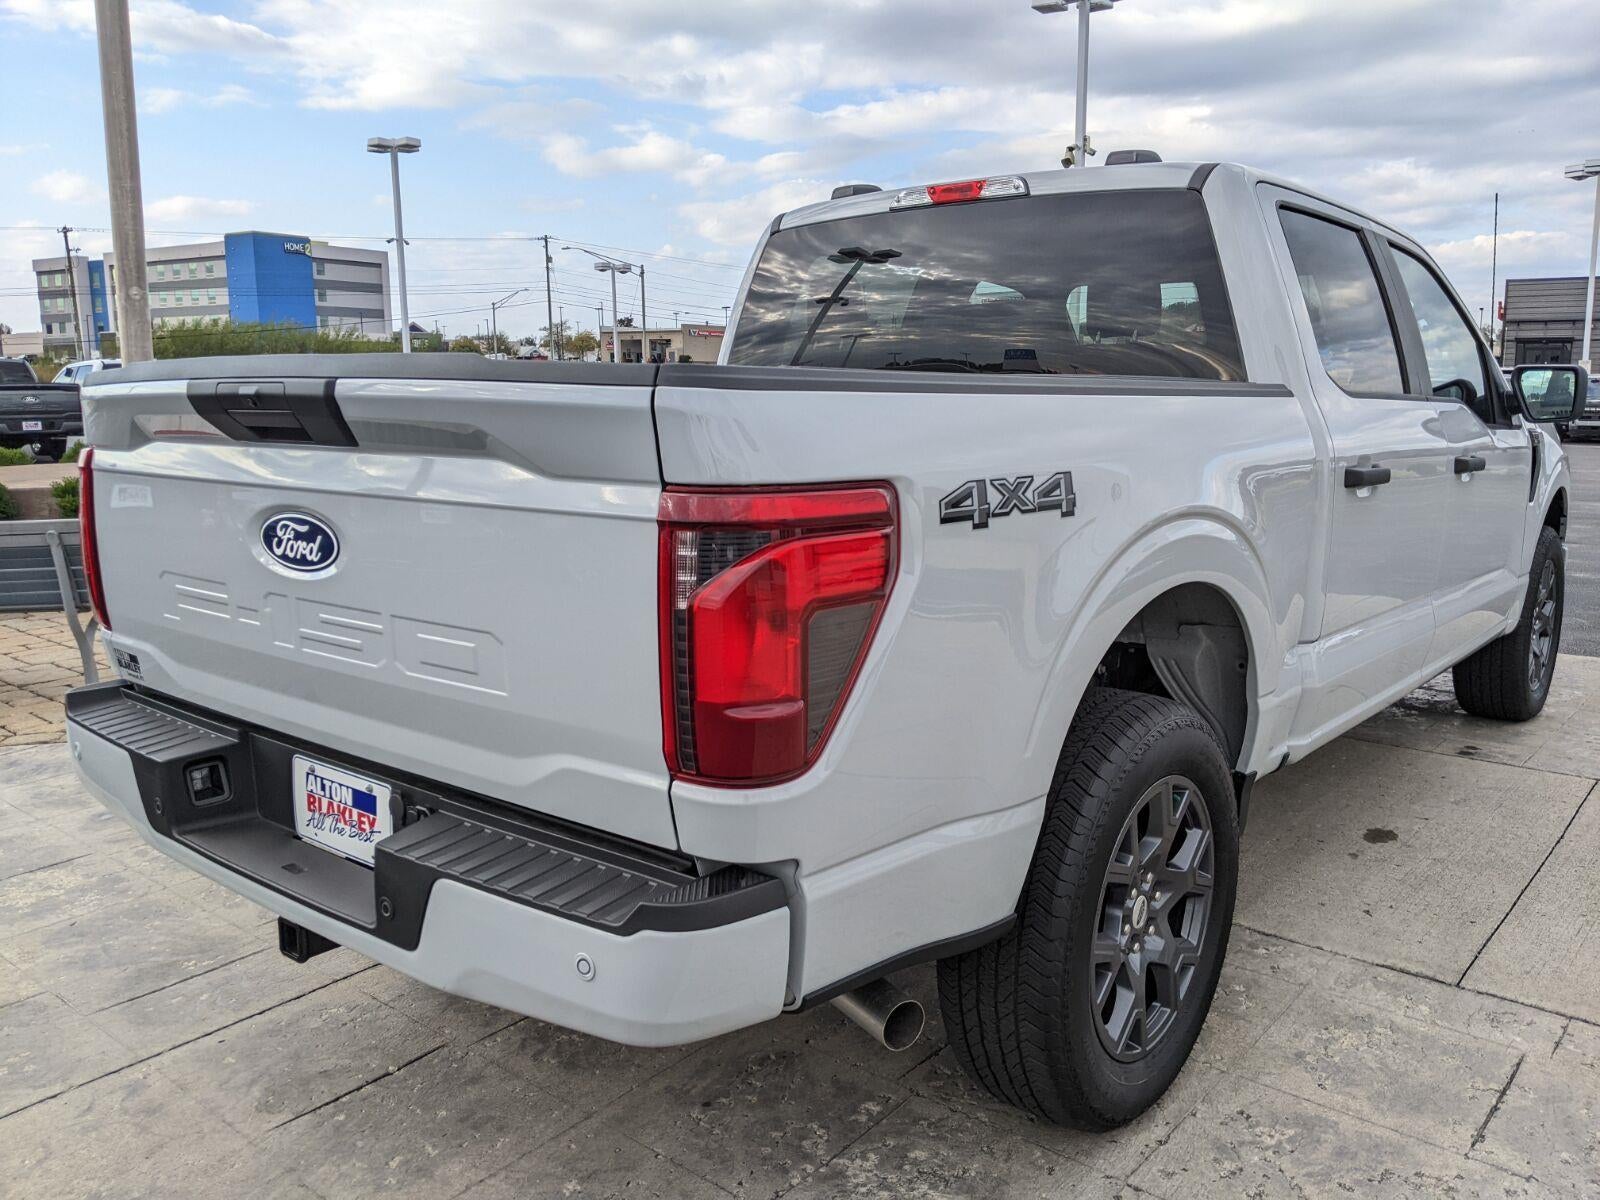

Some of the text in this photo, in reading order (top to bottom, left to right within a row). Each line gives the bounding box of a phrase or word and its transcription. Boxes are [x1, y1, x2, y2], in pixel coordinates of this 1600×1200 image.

[272, 520, 322, 562] Ford
[159, 571, 508, 697] F-150
[307, 773, 353, 807] ALTON
[306, 793, 377, 834] BLAKLEY
[306, 810, 382, 843] All The Best
